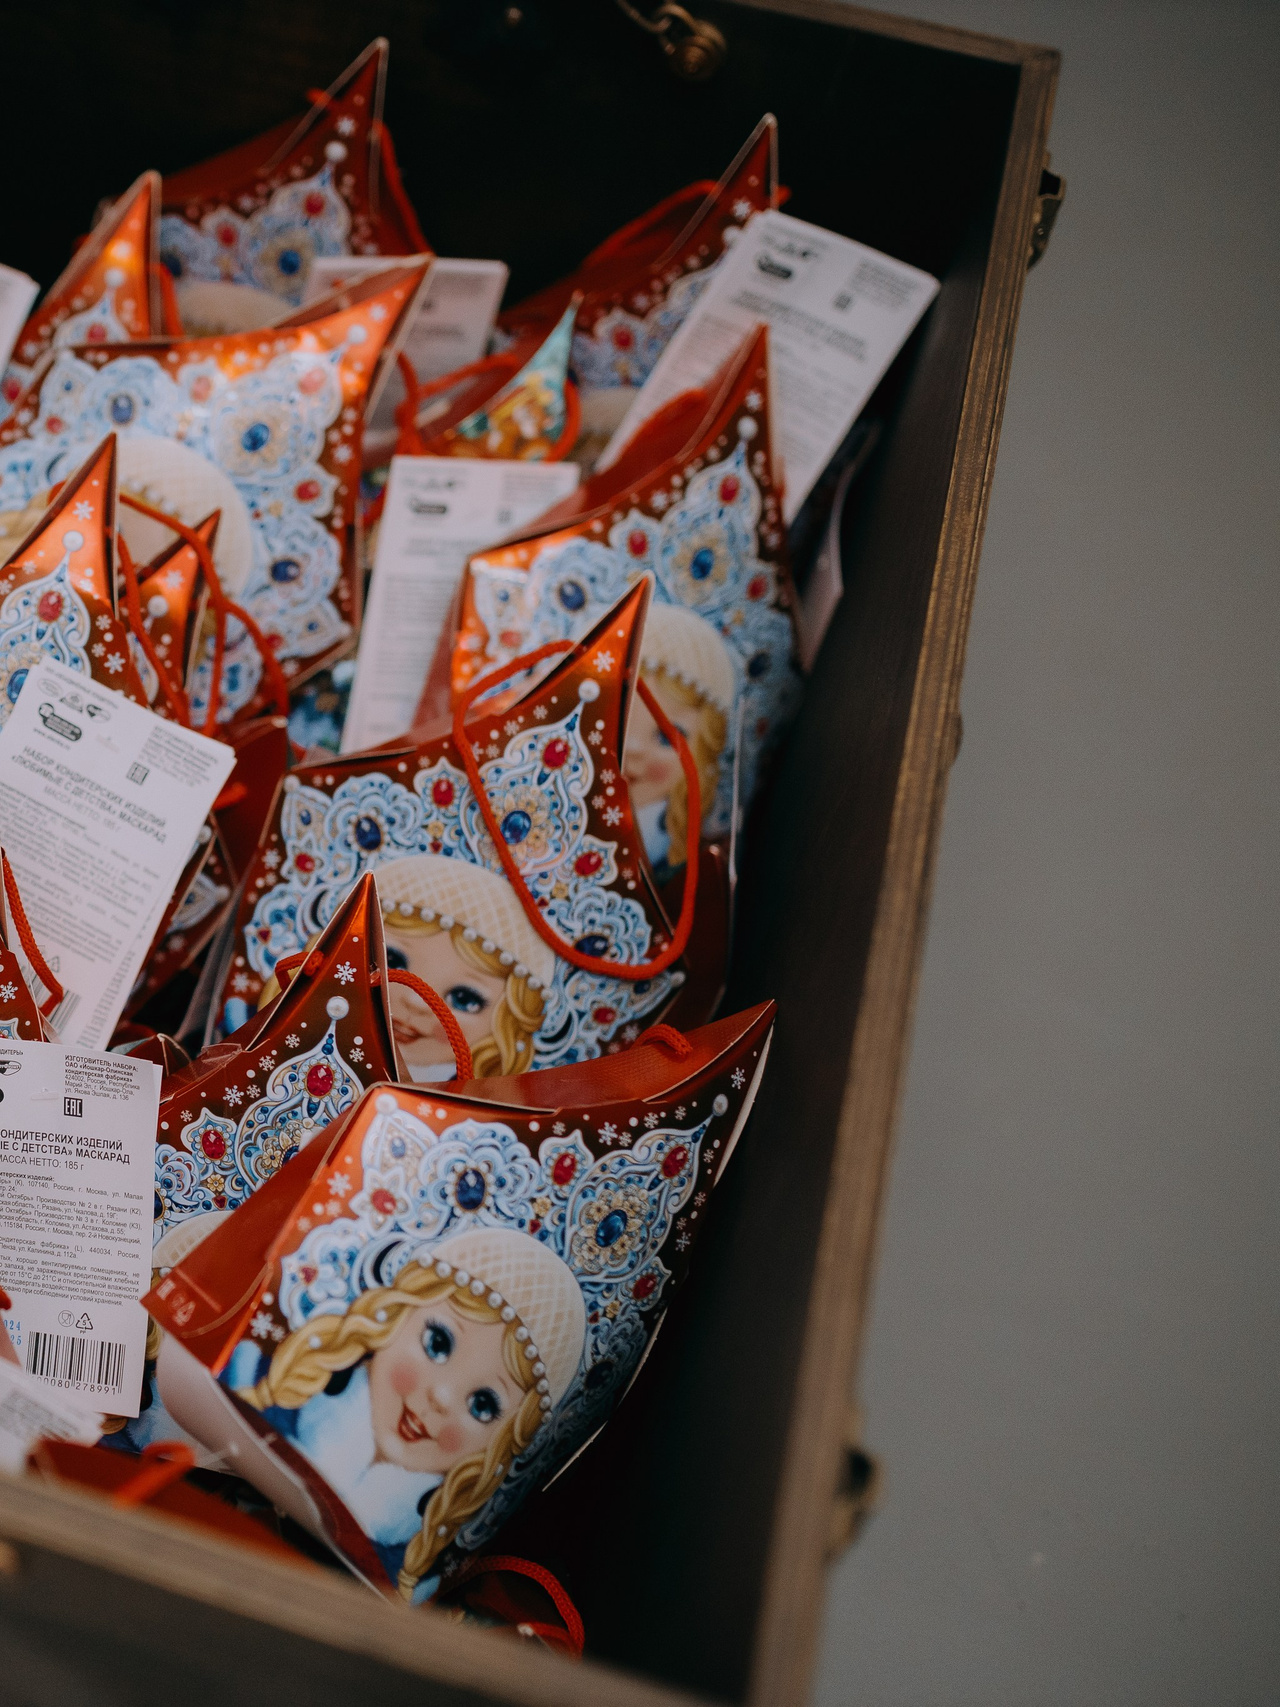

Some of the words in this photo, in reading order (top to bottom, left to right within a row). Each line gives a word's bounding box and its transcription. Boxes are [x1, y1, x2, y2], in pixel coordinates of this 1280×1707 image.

[64, 1054, 111, 1066] ИЗГОТОВИТЕЛЬ
[112, 1062, 138, 1071] НАБОРА:
[64, 1060, 78, 1068] ОАО
[65, 1069, 102, 1079] кондитерская
[104, 1073, 132, 1082] фабрика»
[65, 1098, 82, 1117] EAC
[76, 1135, 122, 1151] ИЗДЕЛИЙ
[12, 1141, 18, 1151] С
[21, 1141, 72, 1158] ДЕТСТВА»
[75, 1147, 130, 1164] МАСКАРАД
[29, 1156, 61, 1168] НЕТТО:
[64, 1160, 78, 1170] 185
[27, 1173, 54, 1182] изделий:
[86, 1187, 108, 1196] Москва,
[124, 1192, 143, 1200] Малая
[6, 1192, 33, 1202] Октябрь»
[36, 1195, 76, 1206] Производство
[106, 1204, 127, 1212] Рязани
[5, 1206, 31, 1216] Октябрь»
[33, 1210, 73, 1220] Производство
[101, 1218, 127, 1227] Коломне
[25, 1223, 46, 1232] Россия,
[40, 1240, 68, 1250] фабрика»
[117, 1250, 140, 1259] Россия,
[4, 1262, 25, 1270] запаха,
[36, 1267, 71, 1276] зараженных
[73, 1272, 112, 1282] вредителями
[113, 1276, 139, 1285] хлебных
[16, 1256, 37, 1265] хорошо
[41, 1260, 86, 1271] вентилируемых
[90, 1266, 128, 1277] помещениях,
[8, 1278, 40, 1287] подвергать
[41, 1281, 79, 1292] воздействию
[79, 1288, 104, 1297] прямого
[104, 1291, 138, 1300] солнечного
[62, 1278, 106, 1289] относительной
[107, 1284, 138, 1293] влажности
[33, 1288, 68, 1299] соблюдении
[70, 1293, 93, 1303] условий
[75, 1381, 116, 1396] 278991
